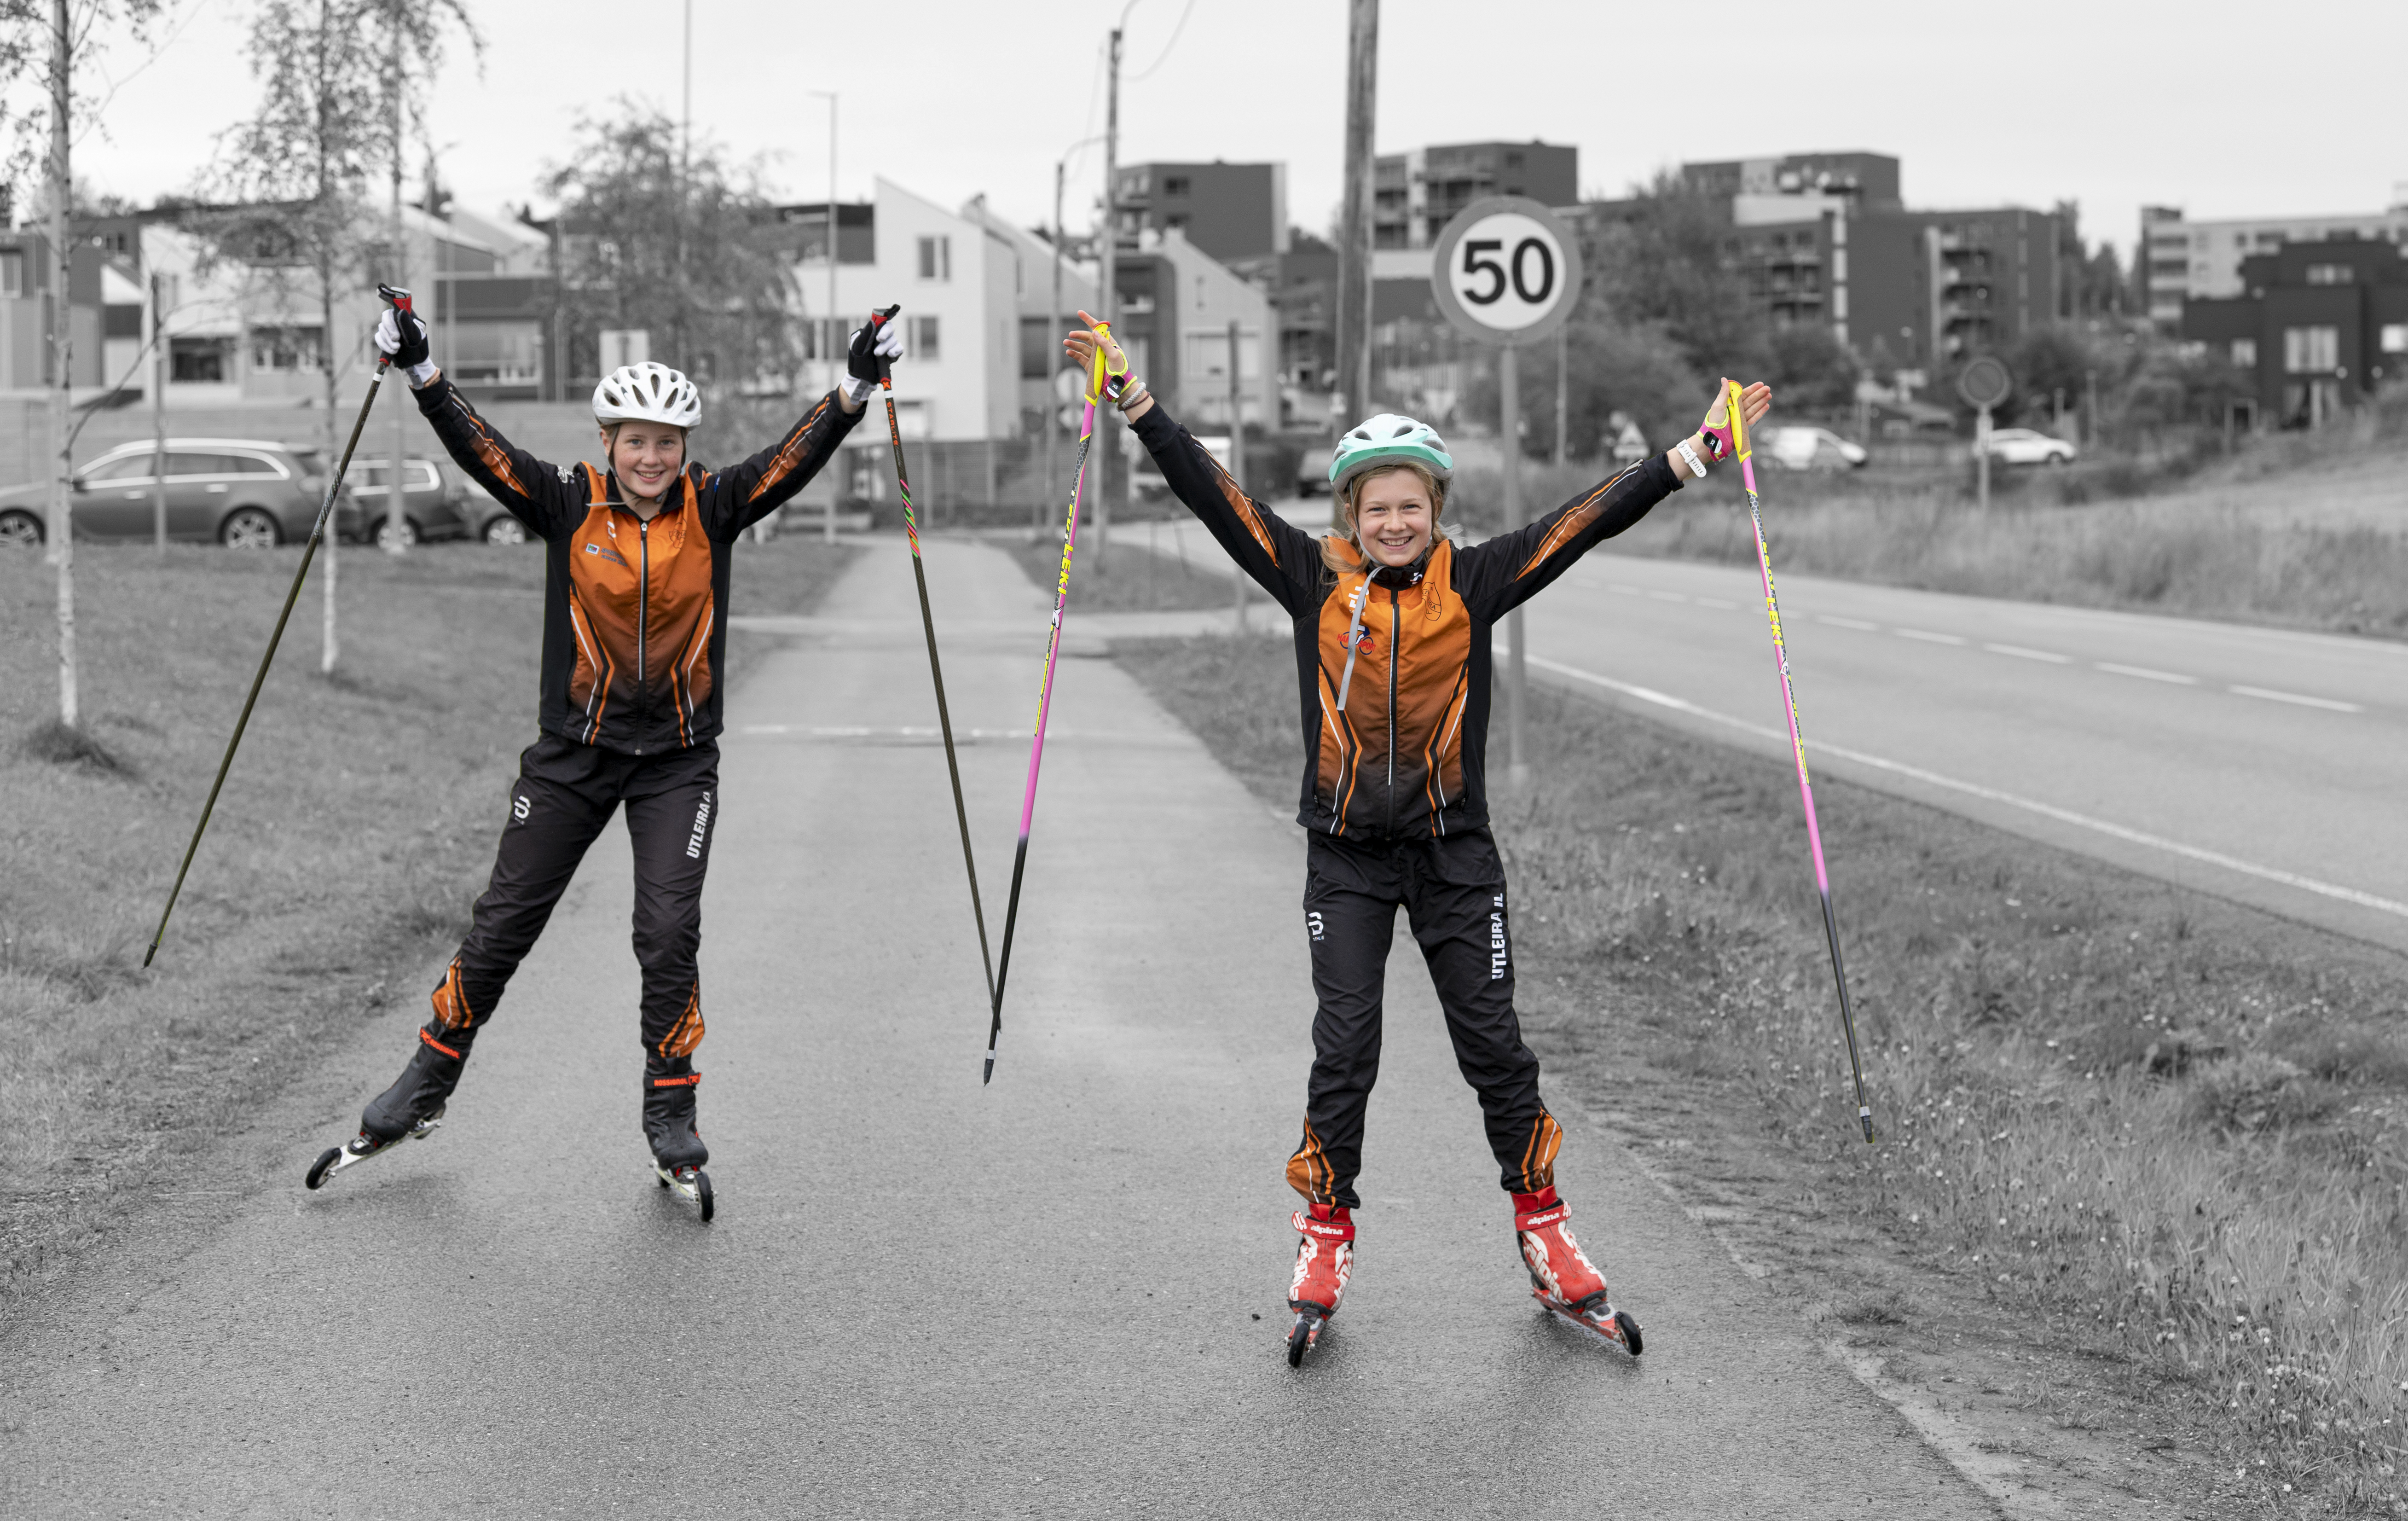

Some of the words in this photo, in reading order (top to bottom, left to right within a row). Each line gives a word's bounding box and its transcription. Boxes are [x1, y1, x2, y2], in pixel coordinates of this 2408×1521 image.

[1463, 237, 1554, 305] 50
[887, 401, 898, 445] STARLITE
[1058, 543, 1073, 595] LEKI
[1766, 597, 1783, 646] LEKI
[686, 803, 710, 859] UTLEIRA
[1493, 893, 1503, 907] IL
[1491, 912, 1507, 979] UTLEIRA
[654, 1078, 688, 1086] ROSSIGNOL
[1310, 1225, 1343, 1235] alpina
[1527, 1212, 1560, 1225] alpina
